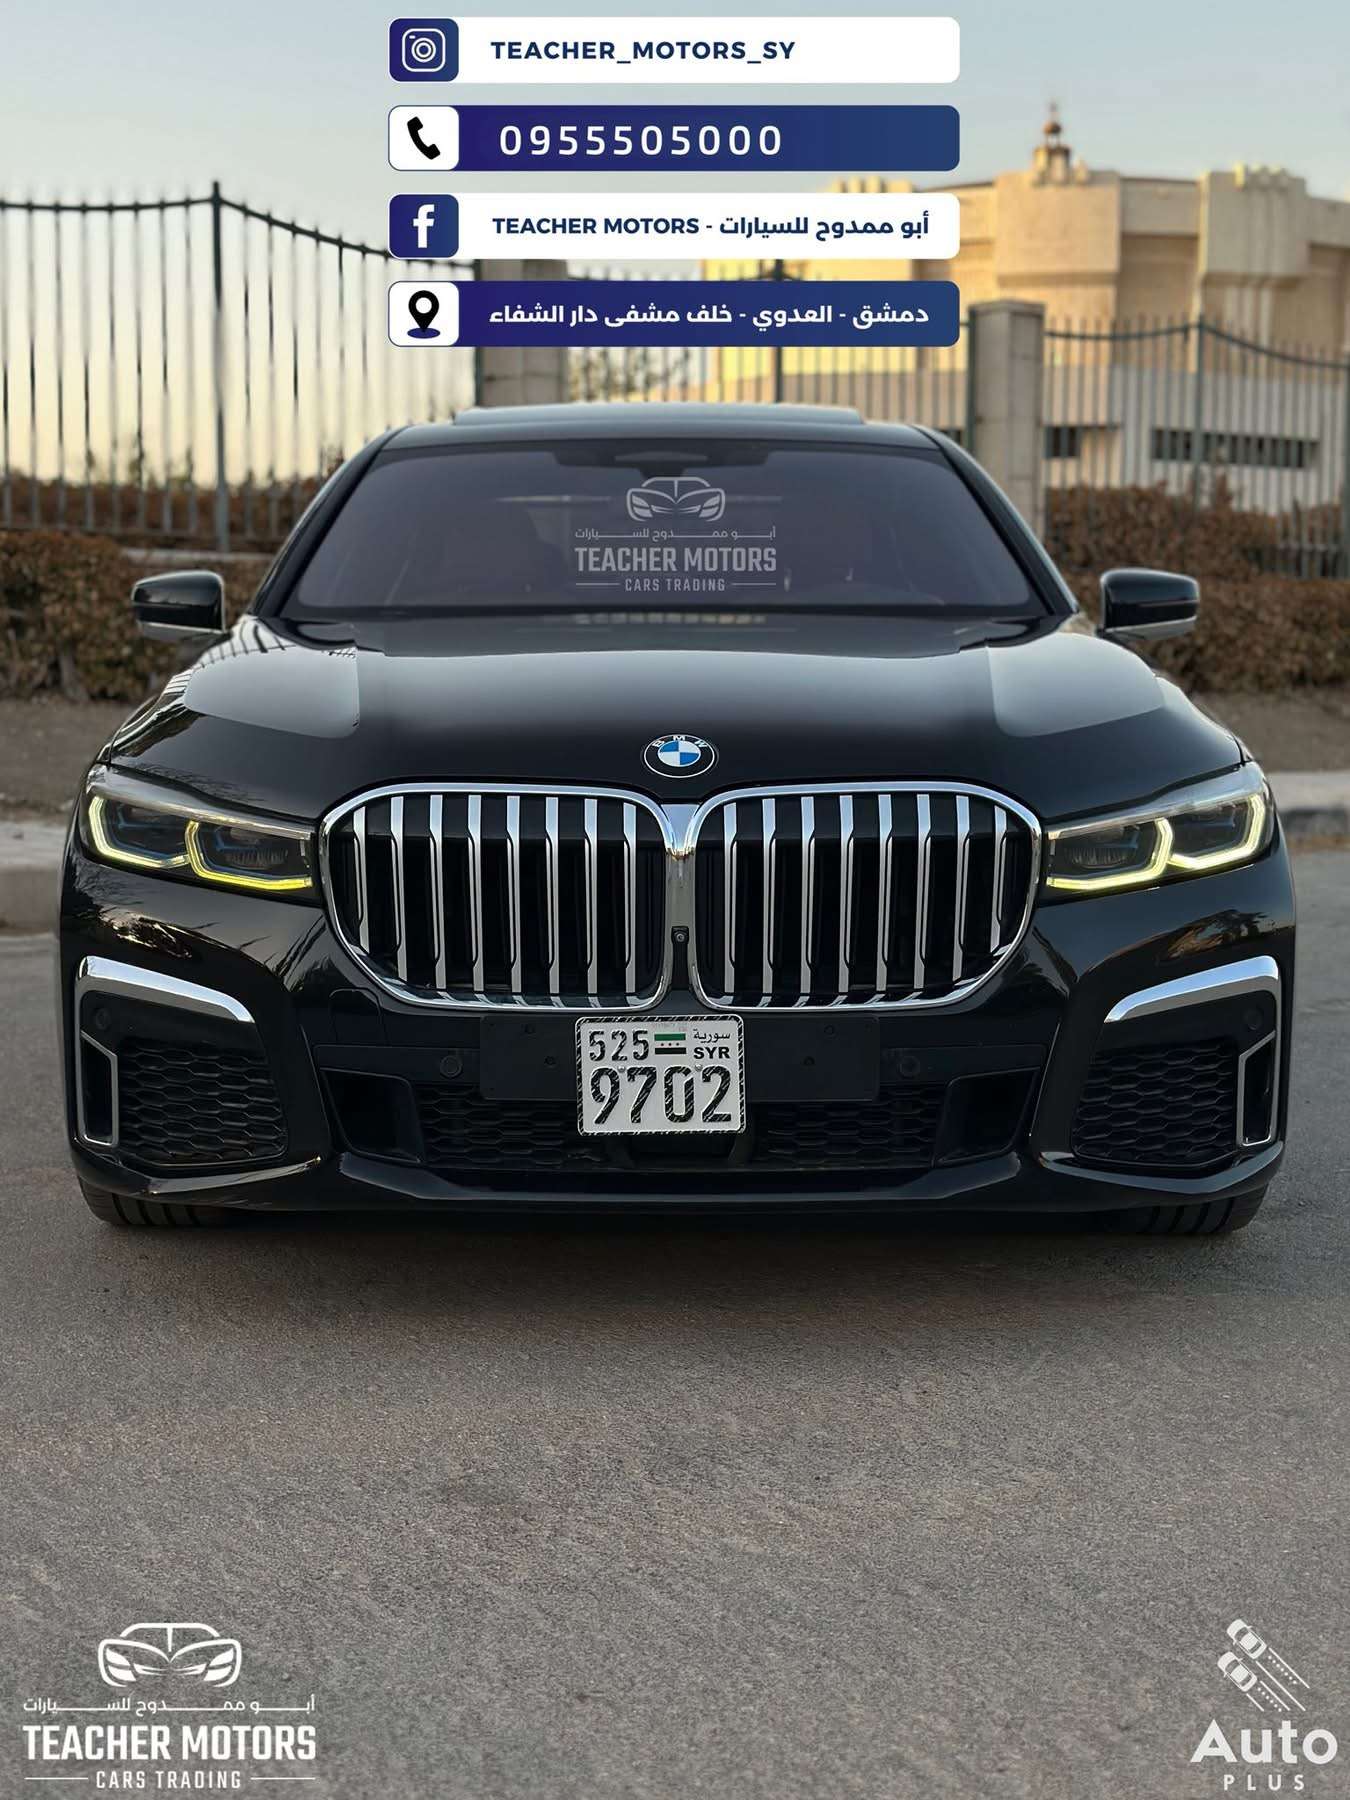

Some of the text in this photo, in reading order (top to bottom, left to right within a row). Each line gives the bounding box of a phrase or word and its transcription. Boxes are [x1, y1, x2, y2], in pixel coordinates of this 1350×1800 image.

[588, 1029, 650, 1062] 525
[693, 1028, 731, 1043] سورية
[693, 1046, 731, 1059] SYR
[590, 1065, 732, 1124] 9702
